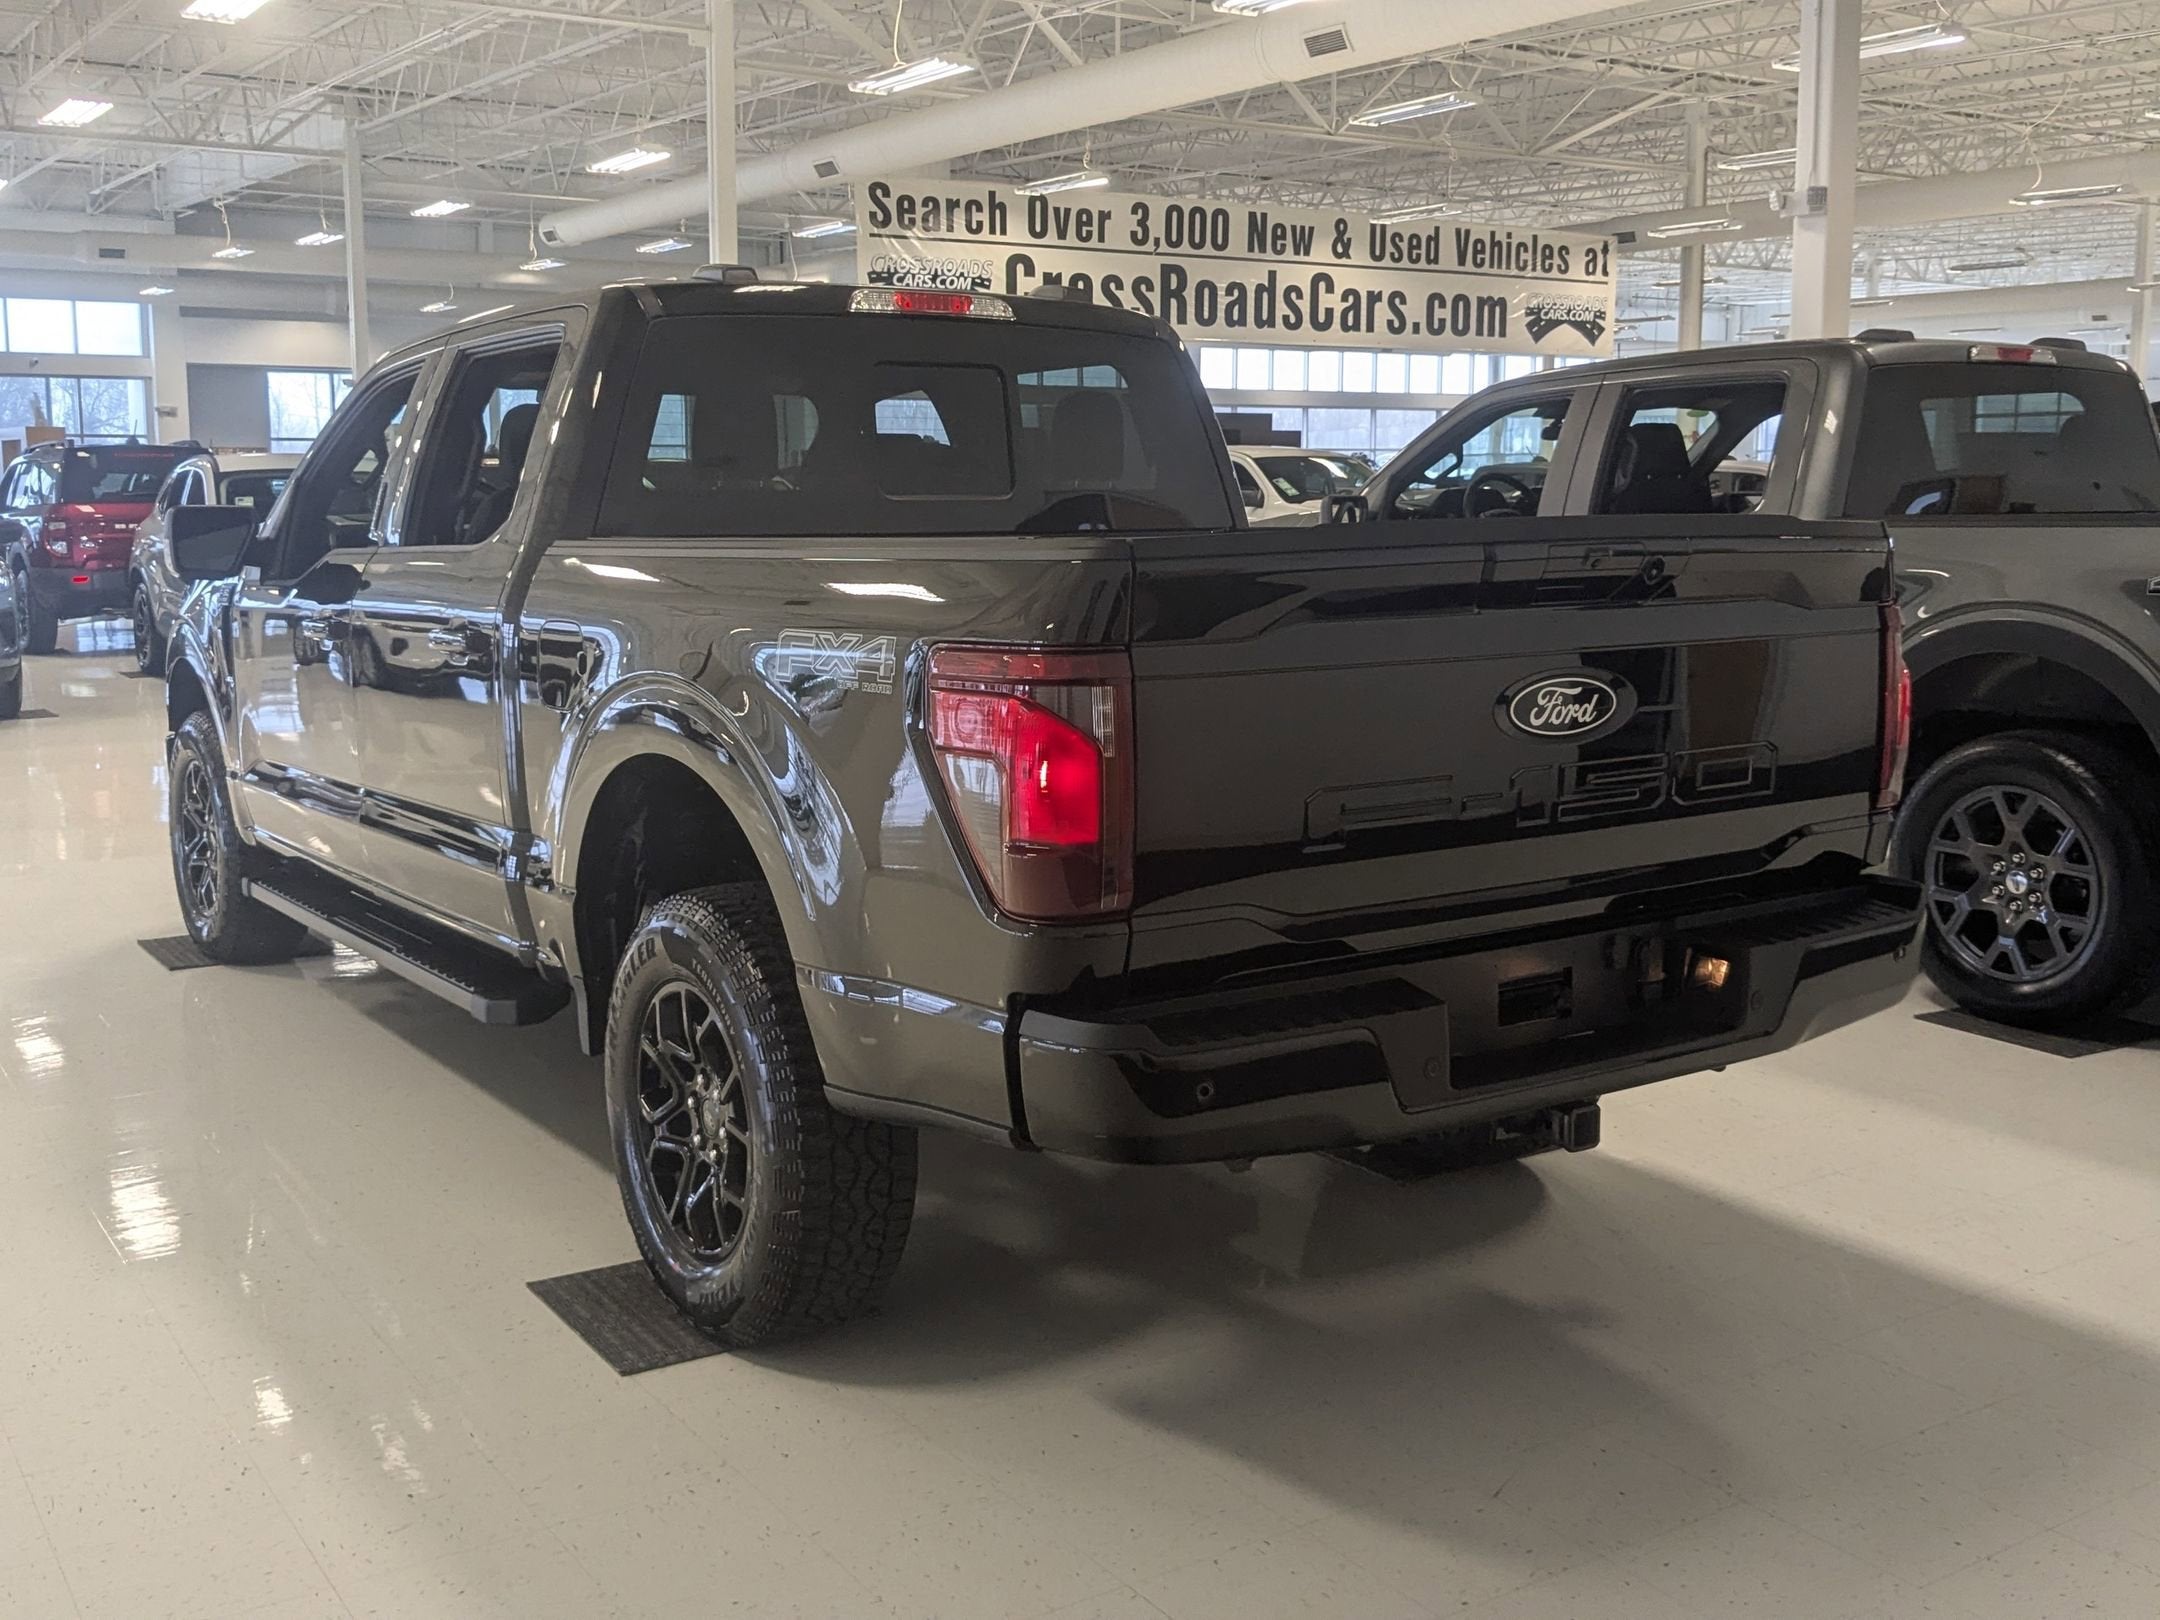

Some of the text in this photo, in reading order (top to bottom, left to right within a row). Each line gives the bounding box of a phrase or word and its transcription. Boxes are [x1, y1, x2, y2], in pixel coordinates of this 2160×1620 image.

[868, 181, 1609, 277] Search Over 3,000 New & Used Vehicles at
[871, 254, 994, 278] CROSSROADS
[892, 273, 972, 290] CARS.COM
[1526, 292, 1607, 312] CROSSROADS
[1540, 308, 1594, 322] CARS.COM
[776, 628, 896, 682] FX4
[1530, 687, 1600, 726] Ford
[1302, 742, 1777, 852] F-150
